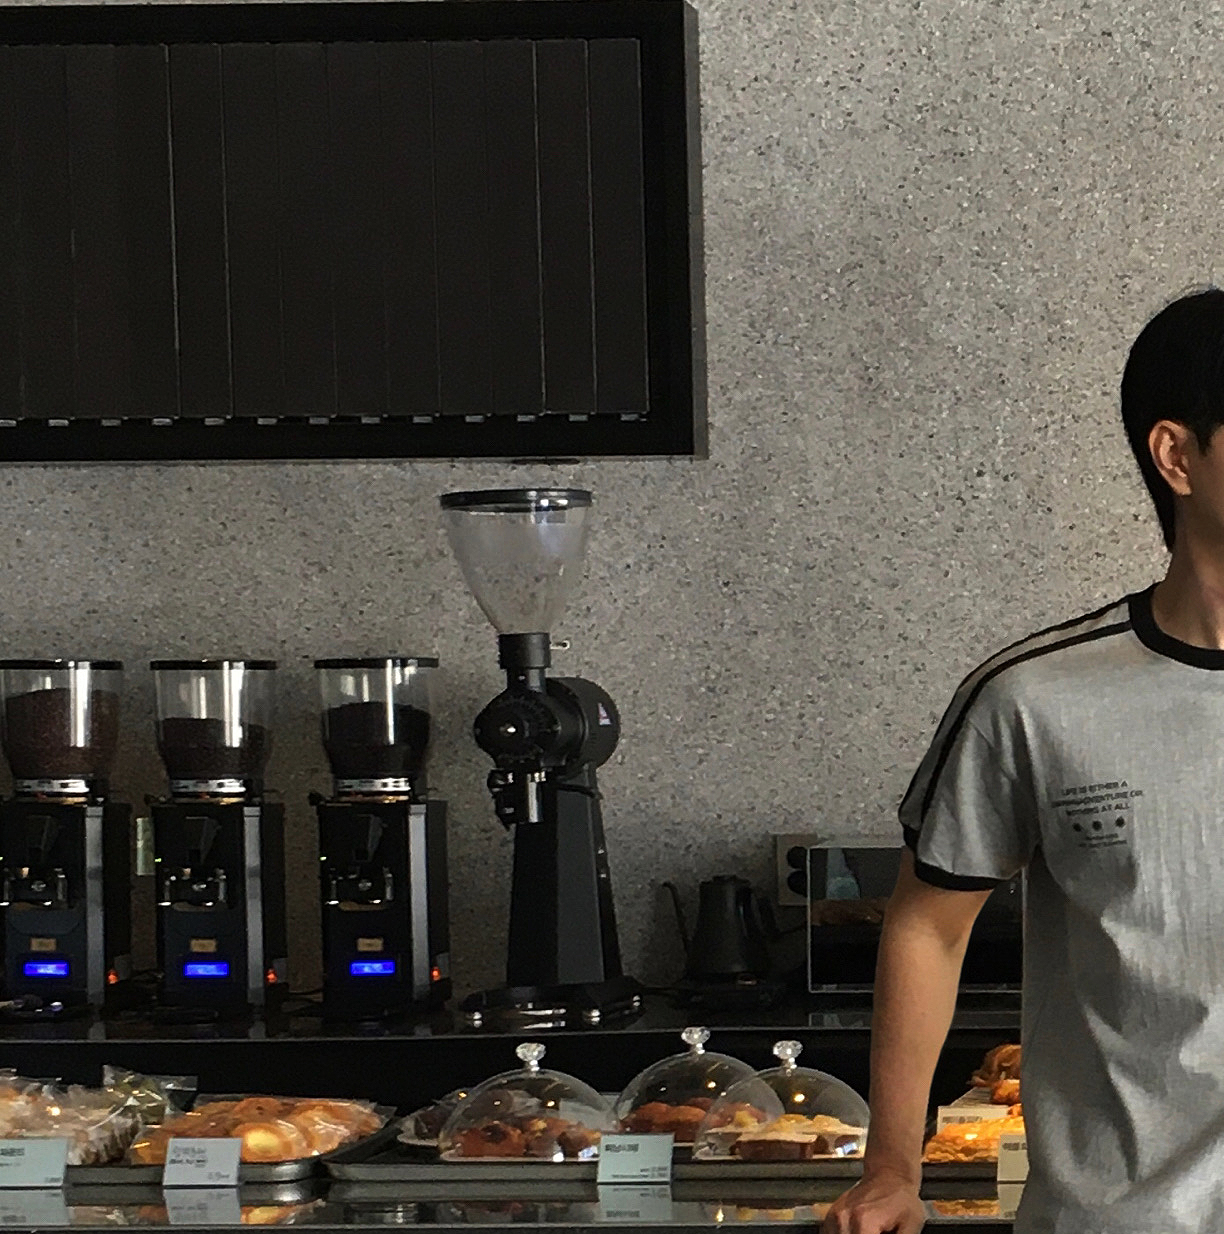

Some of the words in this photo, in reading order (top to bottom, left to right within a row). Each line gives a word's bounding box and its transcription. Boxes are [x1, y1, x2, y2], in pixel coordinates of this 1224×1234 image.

[1121, 780, 1128, 788] A
[1101, 804, 1112, 812] AT
[1115, 802, 1130, 811] ALL
